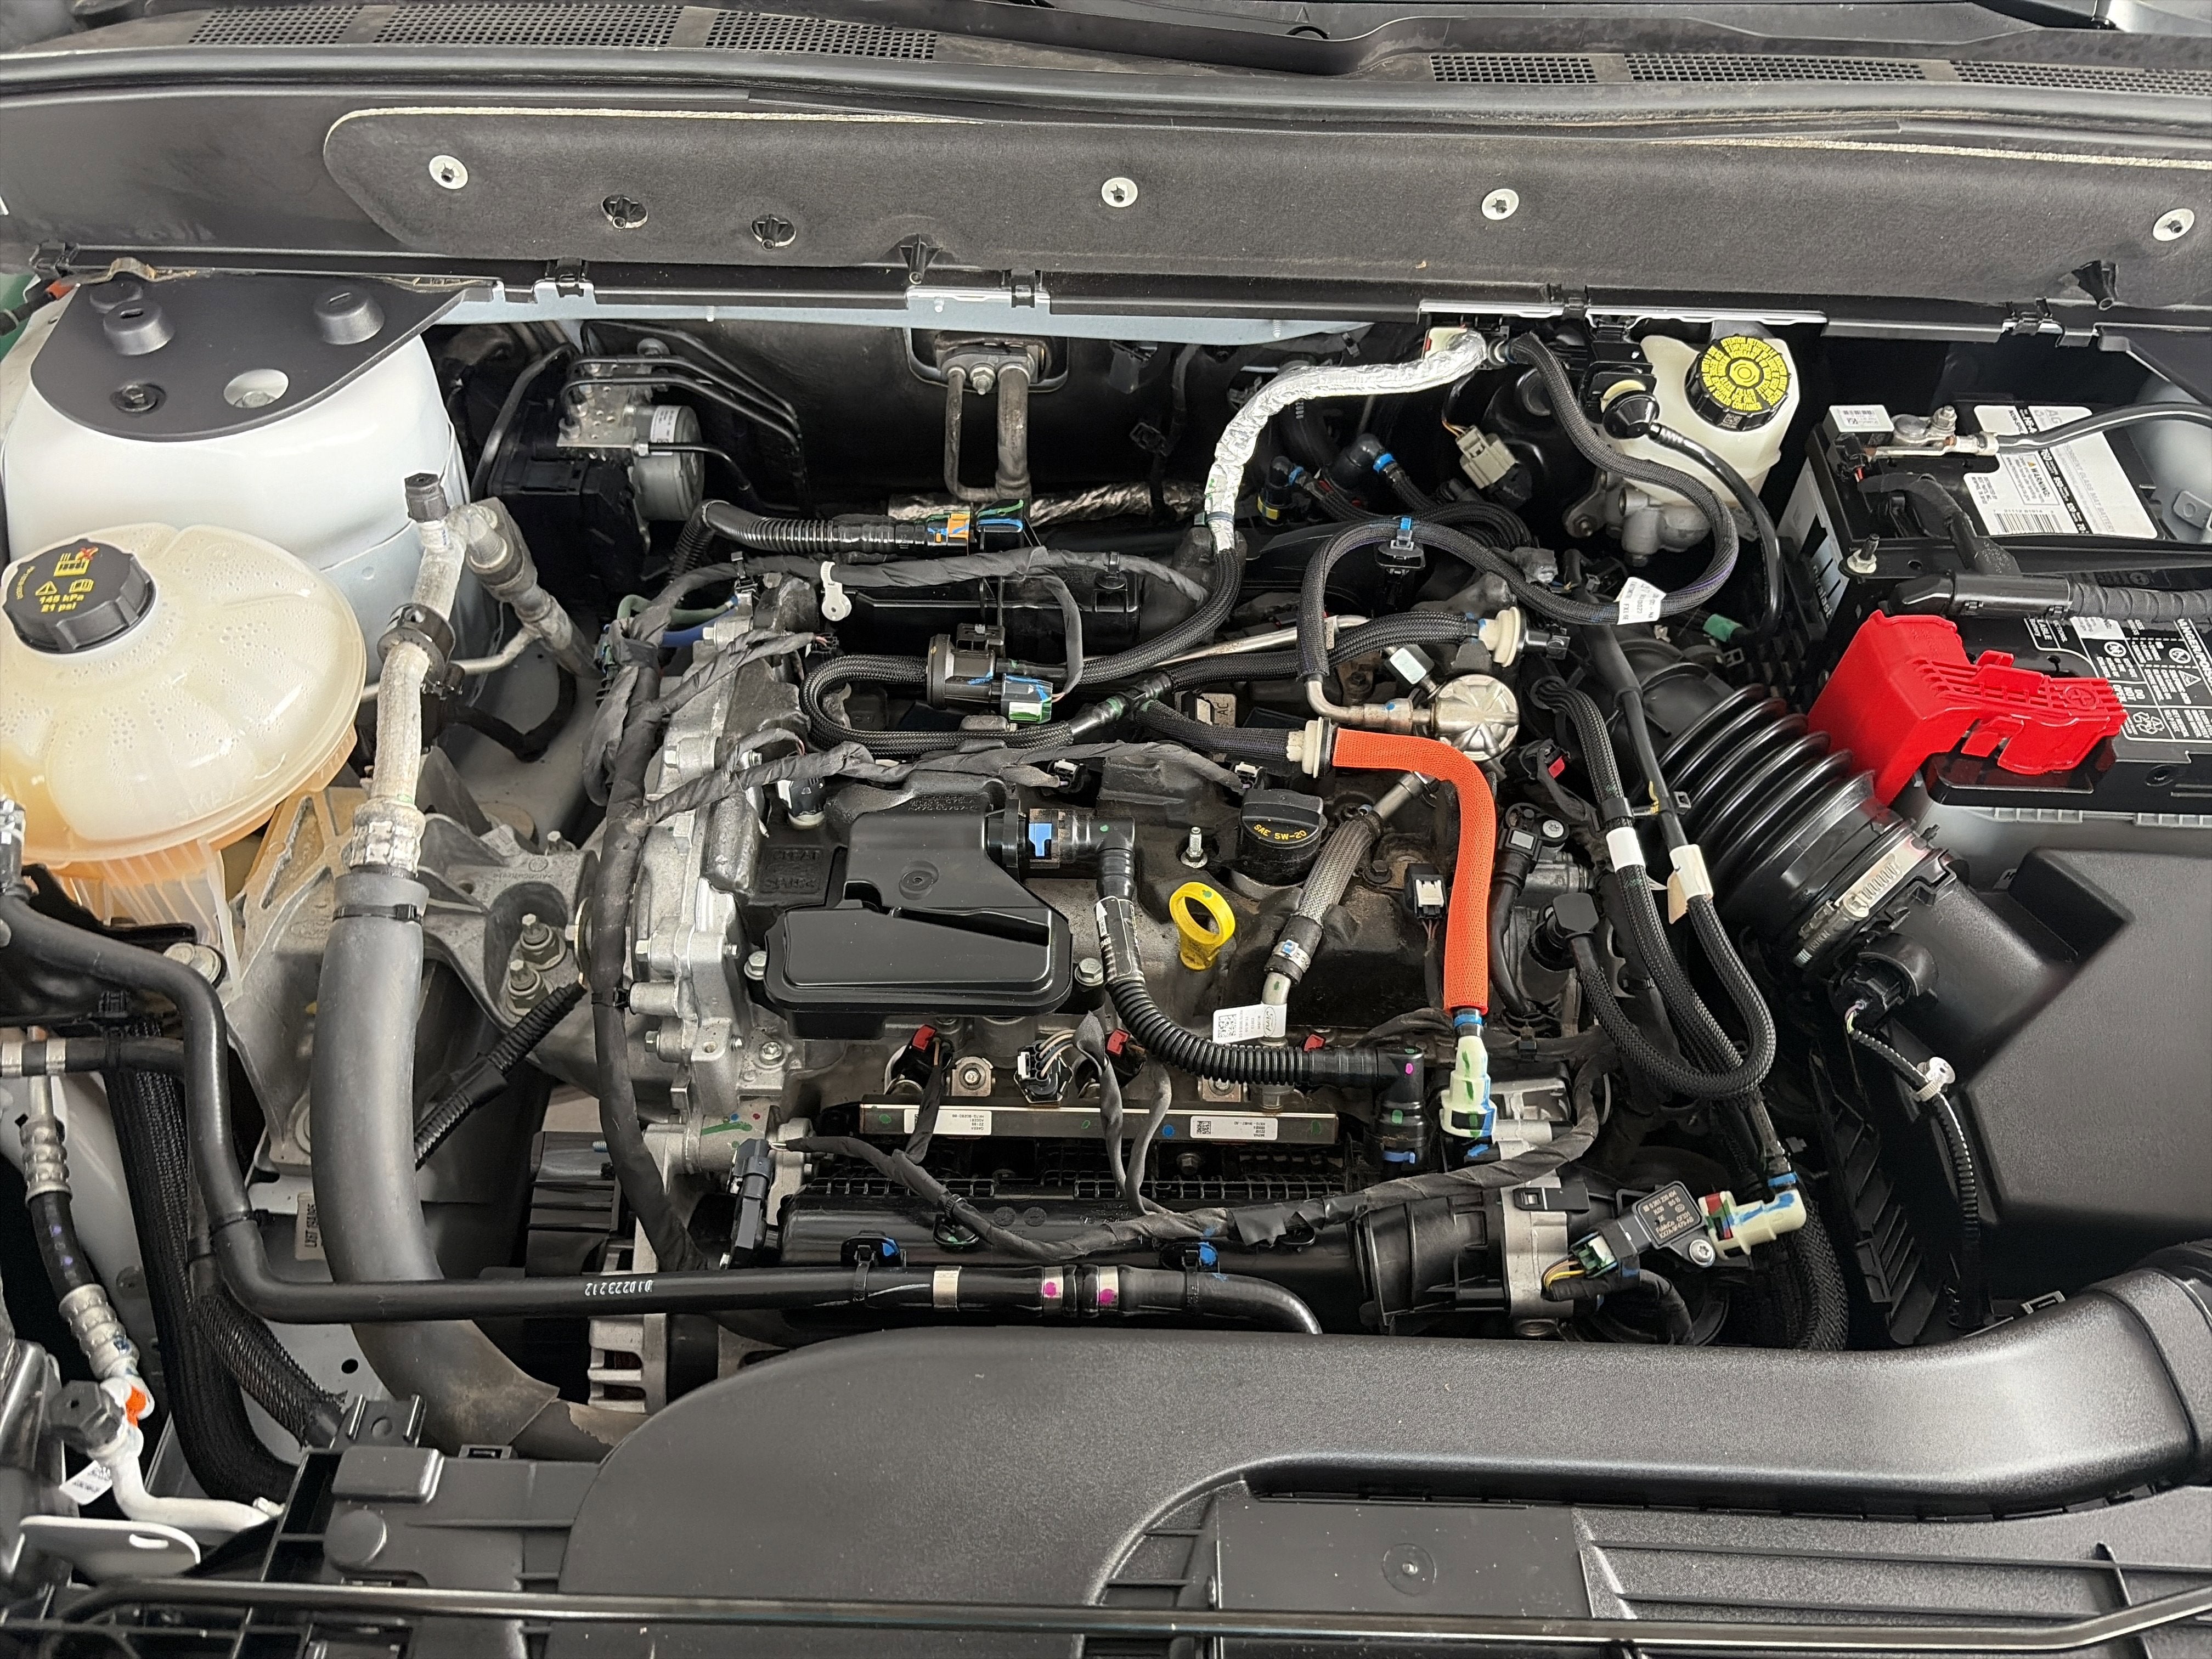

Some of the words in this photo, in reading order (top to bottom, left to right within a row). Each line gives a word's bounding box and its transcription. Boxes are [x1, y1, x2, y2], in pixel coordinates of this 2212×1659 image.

[1722, 336, 1746, 347] ATTENTION
[1747, 338, 1771, 352] NETTOYER
[1732, 400, 1762, 411] CONTAINER
[2031, 467, 2050, 497] WARNING:
[62, 594, 84, 602] kPa
[41, 605, 54, 613] 21
[58, 603, 76, 613] psi
[2123, 686, 2137, 701] NOT
[2134, 689, 2146, 699] DO
[1217, 703, 1229, 716] AC
[1254, 824, 1271, 837] SAE
[1274, 830, 1307, 840] 5W-20
[1265, 1010, 1273, 1032] Ford
